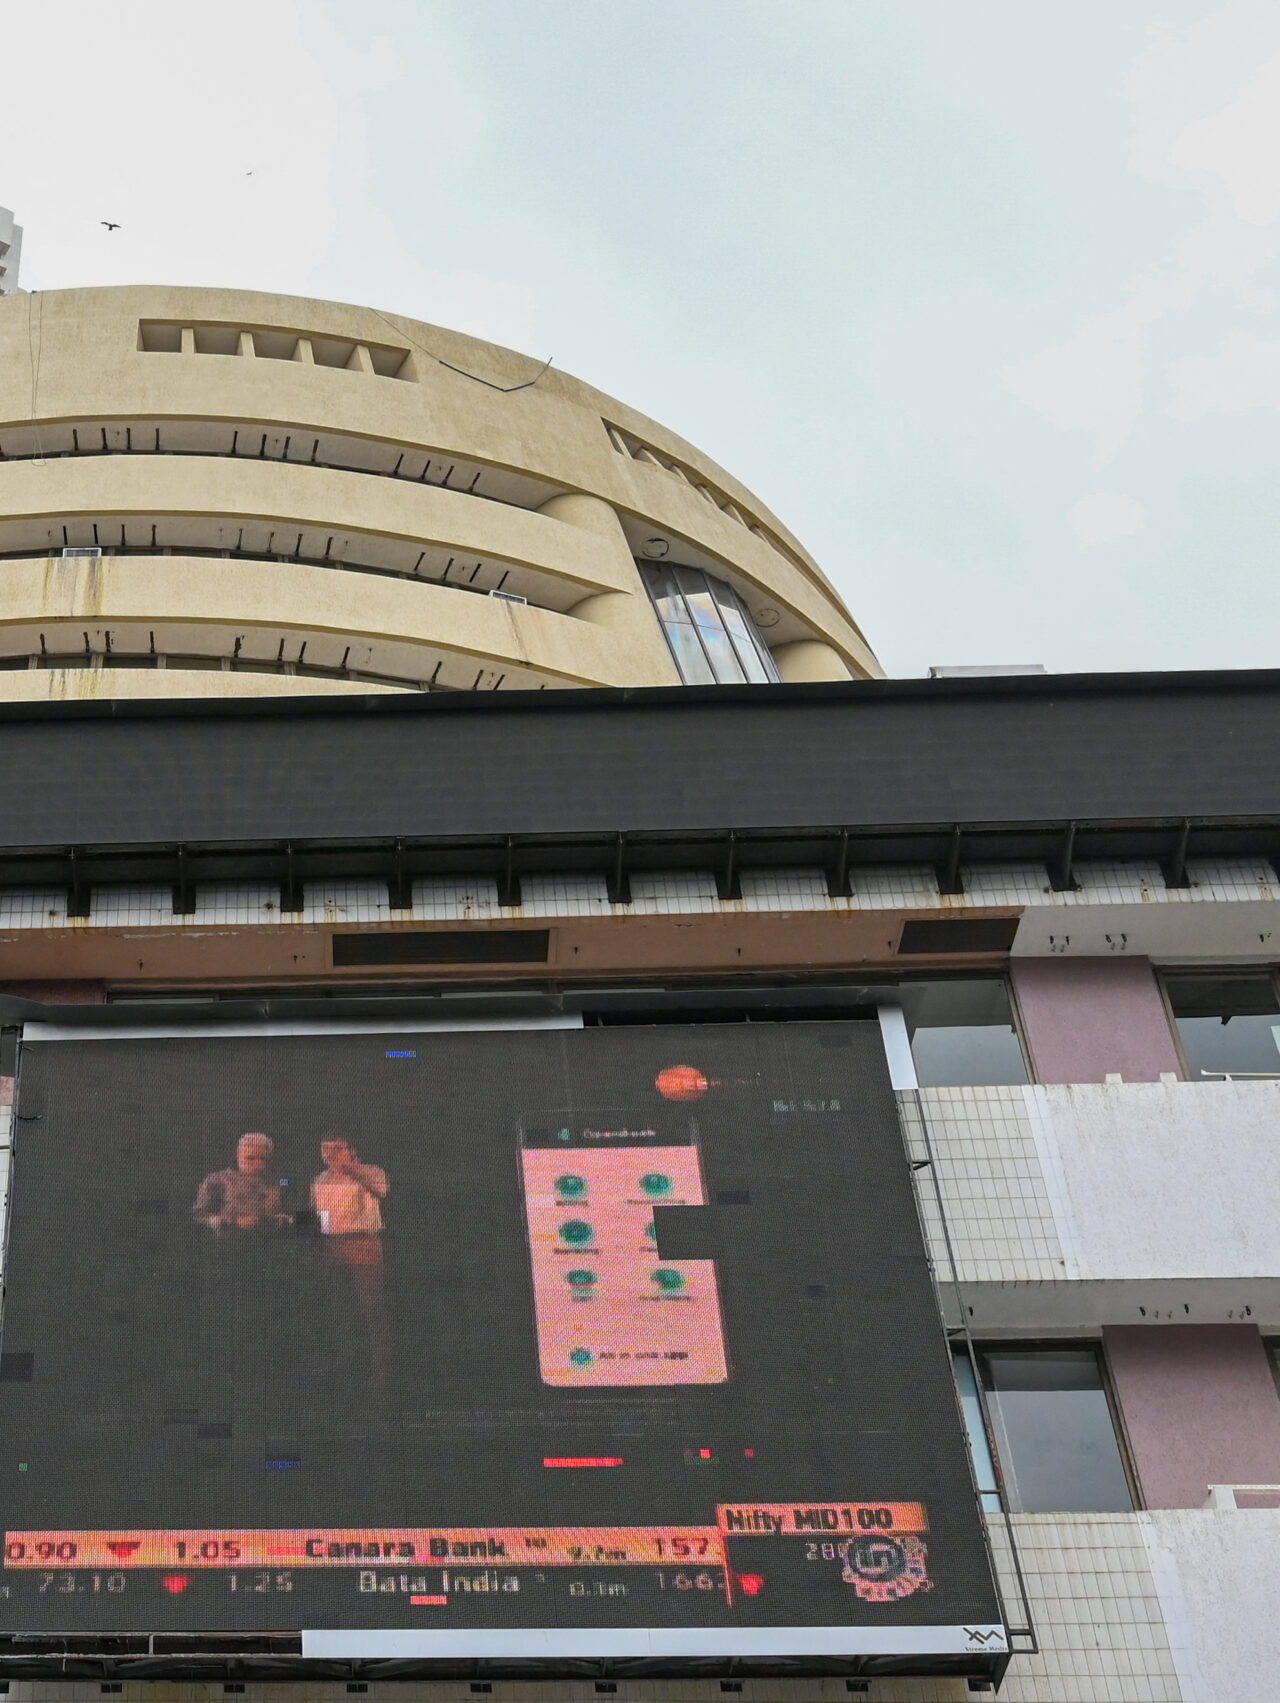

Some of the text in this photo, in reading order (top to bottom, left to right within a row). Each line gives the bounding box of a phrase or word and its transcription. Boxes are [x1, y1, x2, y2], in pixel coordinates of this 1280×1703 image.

[726, 1508, 894, 1536] Nifty MID100
[7, 1542, 77, 1559] 0.90
[176, 1541, 240, 1558] 1.05
[430, 1537, 506, 1557] Bank
[442, 1570, 519, 1592] India
